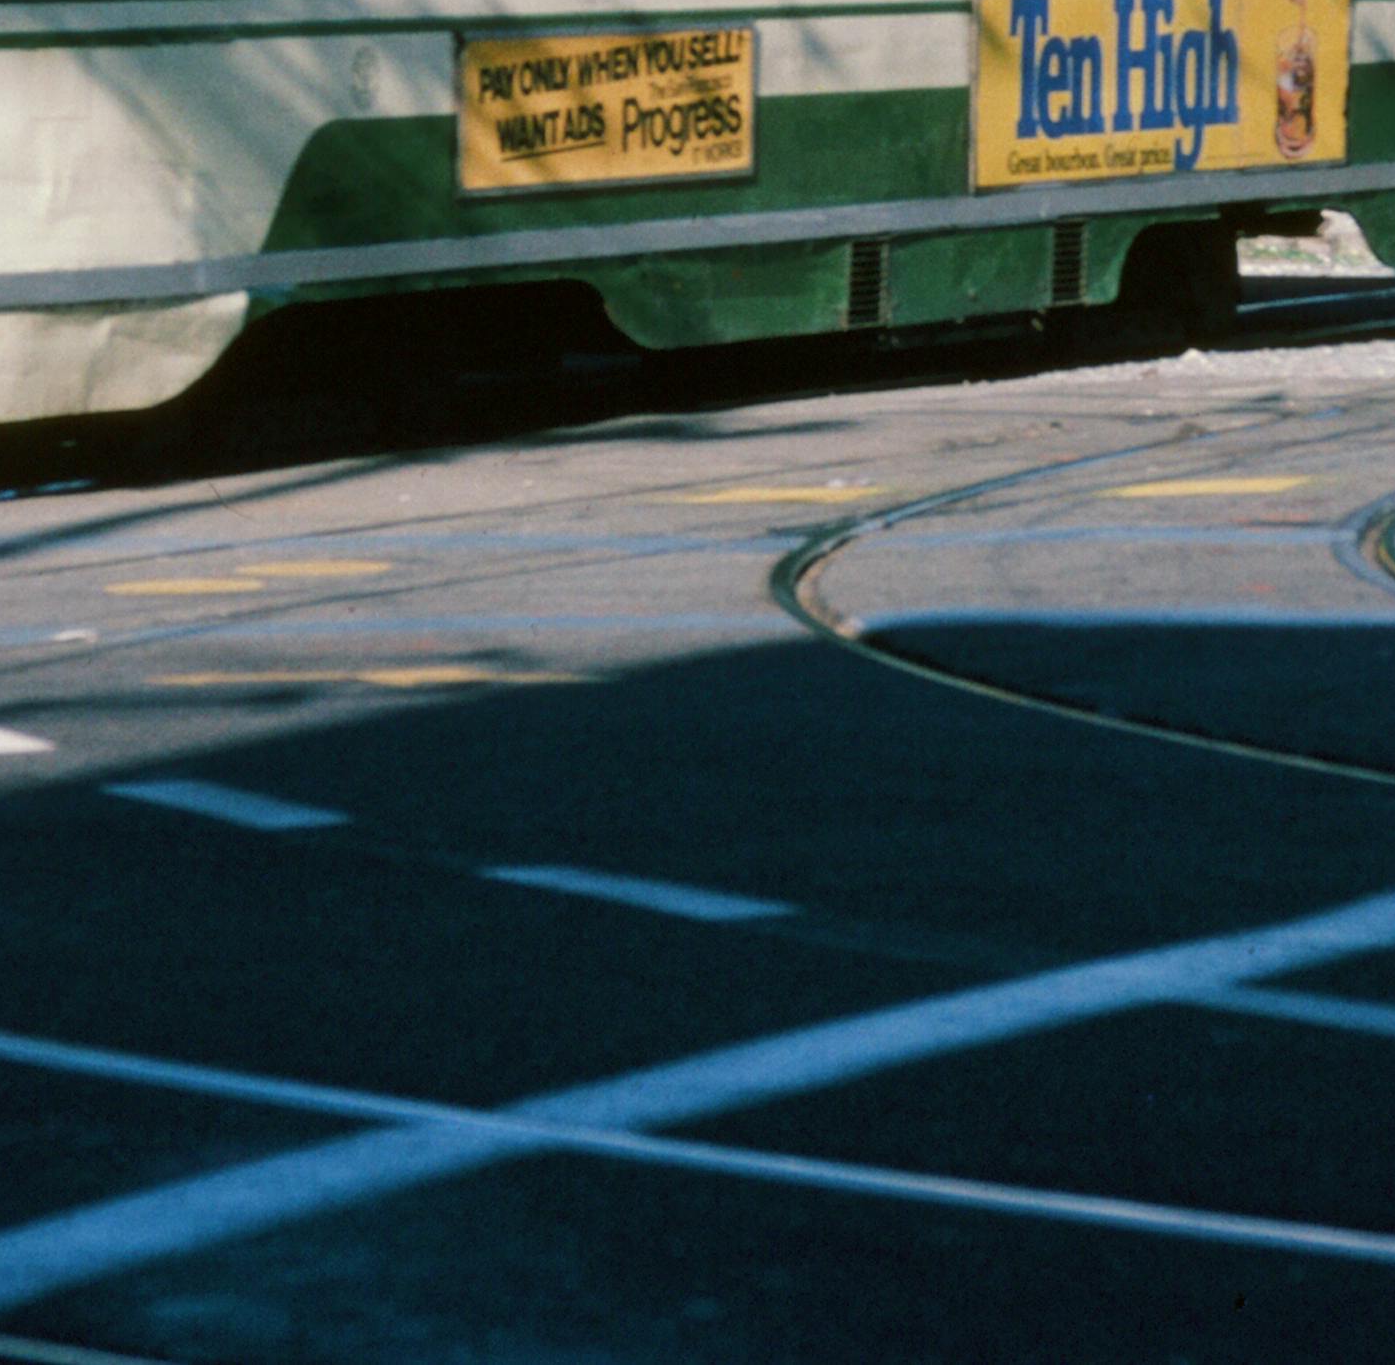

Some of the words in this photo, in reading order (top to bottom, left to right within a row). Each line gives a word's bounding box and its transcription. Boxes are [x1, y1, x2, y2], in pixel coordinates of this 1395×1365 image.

[479, 64, 515, 103] PAY
[520, 56, 572, 96] ONLY
[578, 43, 639, 86] WHEN
[644, 38, 684, 75] YOU
[497, 110, 560, 153] WANT
[564, 102, 605, 142] ADS
[622, 95, 743, 155] Progress
